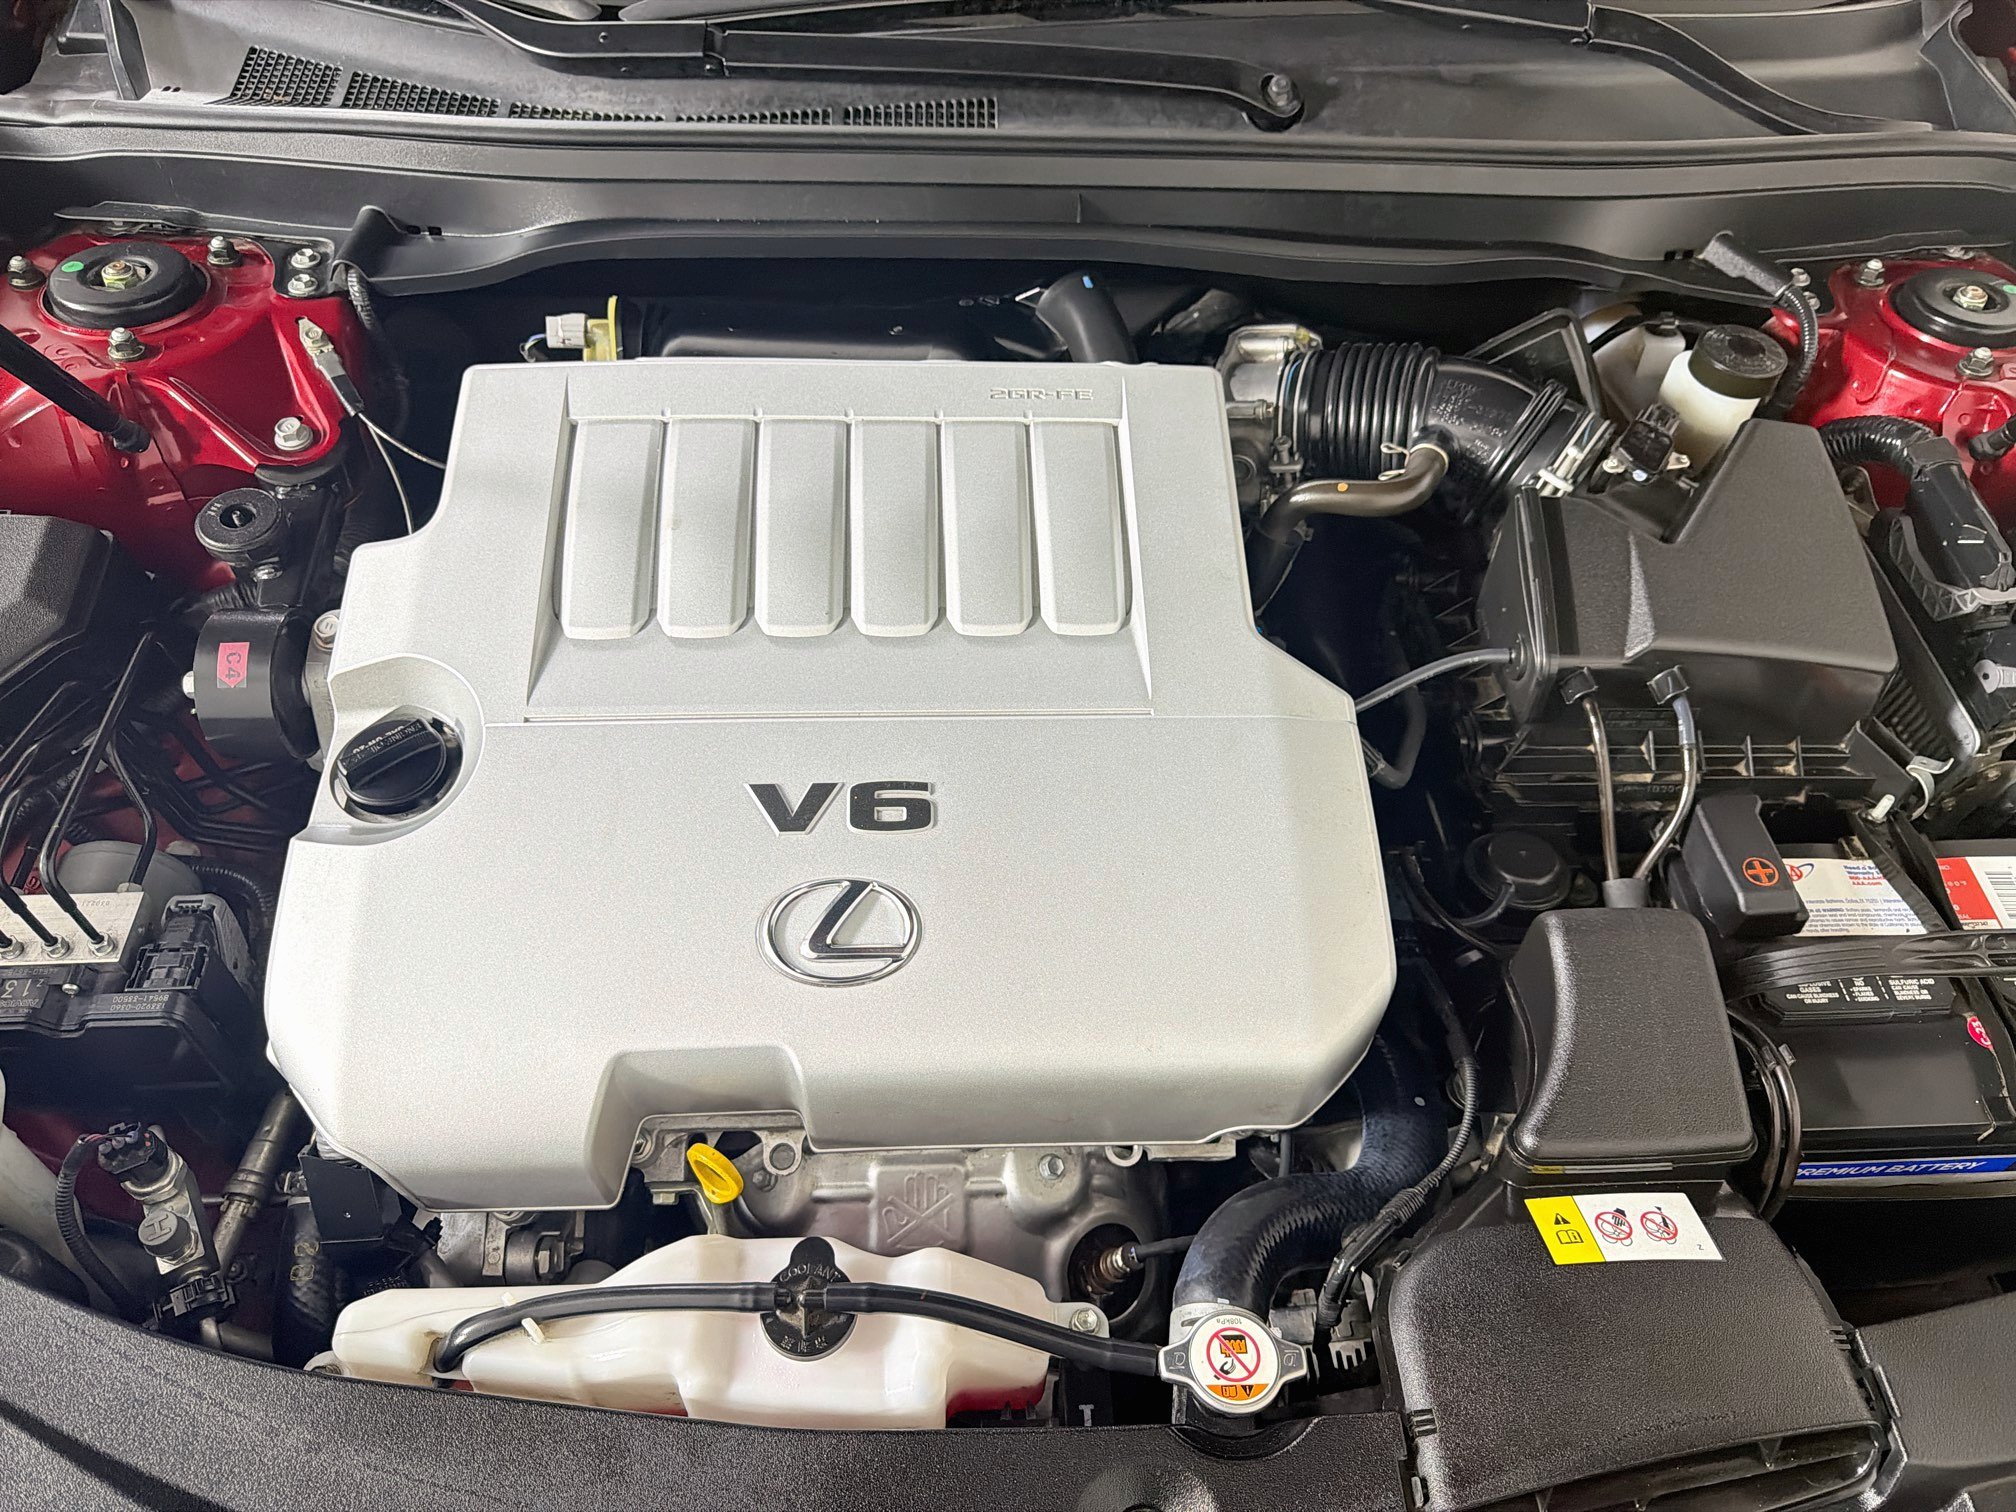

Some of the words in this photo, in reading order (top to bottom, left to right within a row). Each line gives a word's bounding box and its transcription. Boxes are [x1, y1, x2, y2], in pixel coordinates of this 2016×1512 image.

[990, 387, 1093, 400] 2GR-FE
[226, 652, 242, 679] C4
[744, 780, 938, 836] V6
[1884, 1161, 1988, 1174] BATTERY
[1216, 1317, 1242, 1325] 108kPa
